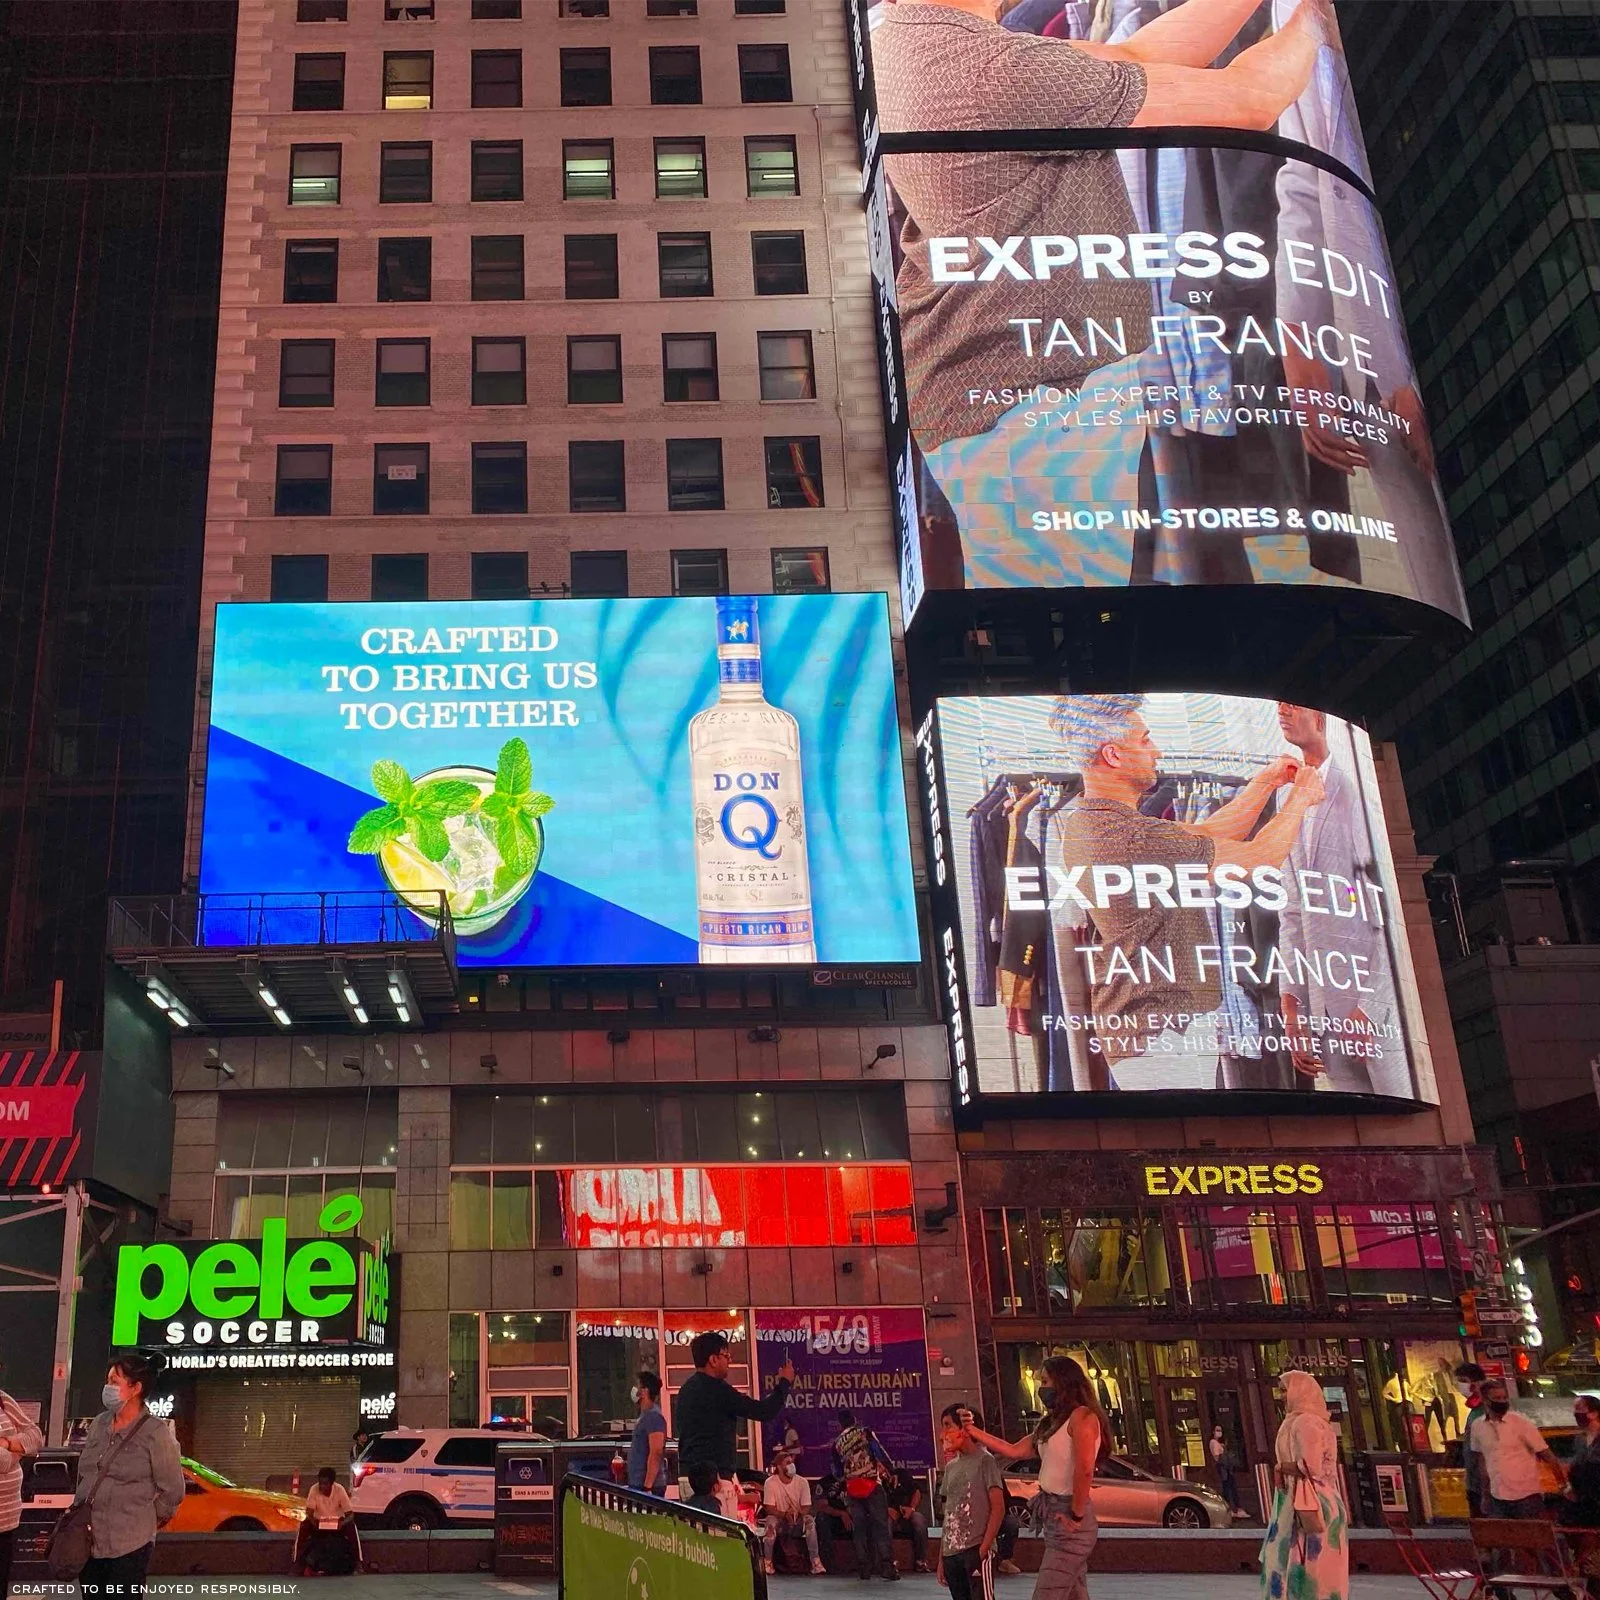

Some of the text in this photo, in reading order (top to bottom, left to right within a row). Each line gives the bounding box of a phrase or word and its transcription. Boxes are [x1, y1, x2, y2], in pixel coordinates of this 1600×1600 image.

[928, 231, 1390, 319] EXPRESS EDIT
[1187, 289, 1214, 305] BY
[1007, 316, 1380, 378] TAN FRANCE
[968, 384, 1412, 436] FASHION EXPERT & TV PERSONALITY
[1023, 408, 1389, 445] STYLES HIS FAVORITE PIECES
[1031, 507, 1399, 543] SHOP IN-STORES & ONLINE
[361, 626, 559, 654] CRAFTED
[321, 661, 598, 692] TO BRING US
[340, 700, 580, 730] TOGETHER
[713, 772, 780, 791] DON
[916, 708, 946, 887] EXPRESS
[719, 793, 783, 861] Q
[716, 872, 789, 883] CRISTAL
[1004, 863, 1384, 927] EXPRESS EDIT
[708, 923, 804, 936] PUERTO RICAN RUM
[1225, 921, 1246, 934] BY
[1074, 944, 1375, 993] TAN FRANCE
[1042, 1012, 1401, 1040] FASHION EXPERT & TV PERSONALITY
[1089, 1035, 1384, 1059] STYLES HIS FAVORITE PIECES
[1144, 1164, 1324, 1195] EXPRESS
[112, 1195, 363, 1346] pelé
[1502, 1312, 1517, 1320] WAY
[166, 1320, 320, 1343] SOCCER
[172, 1355, 227, 1369] WORLD'S
[230, 1354, 296, 1368] GREATEST
[298, 1353, 350, 1367] SOCCER
[351, 1353, 393, 1367] STORE
[765, 1372, 922, 1391] RAIL/RESTAURANT
[361, 1392, 396, 1415] pelé
[819, 1391, 901, 1408] AVAILABLE
[626, 1520, 645, 1544] Give
[678, 1540, 684, 1558] a
[685, 1538, 718, 1572] bubble.
